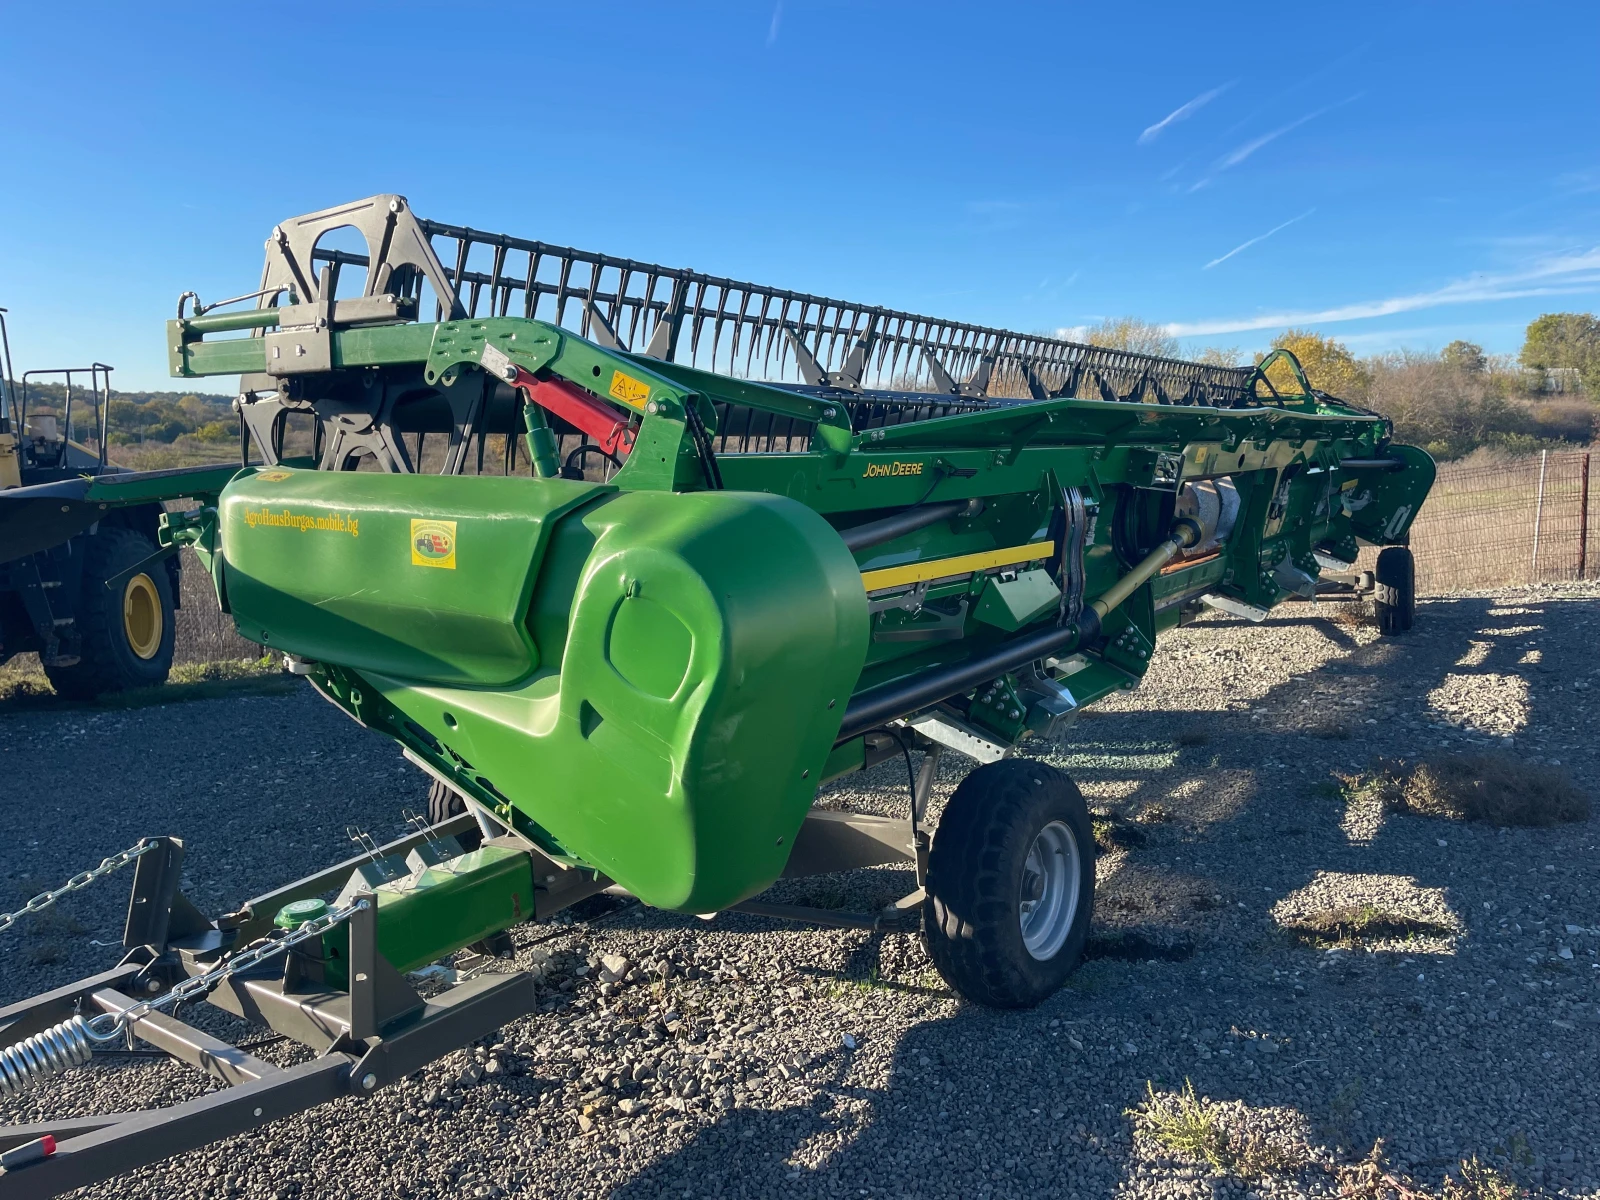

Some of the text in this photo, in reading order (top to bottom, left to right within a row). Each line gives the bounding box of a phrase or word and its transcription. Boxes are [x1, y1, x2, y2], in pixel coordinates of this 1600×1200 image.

[862, 461, 923, 477] JOHN DEERE
[244, 507, 358, 537] AgroHausBurgas.mobile.bg
